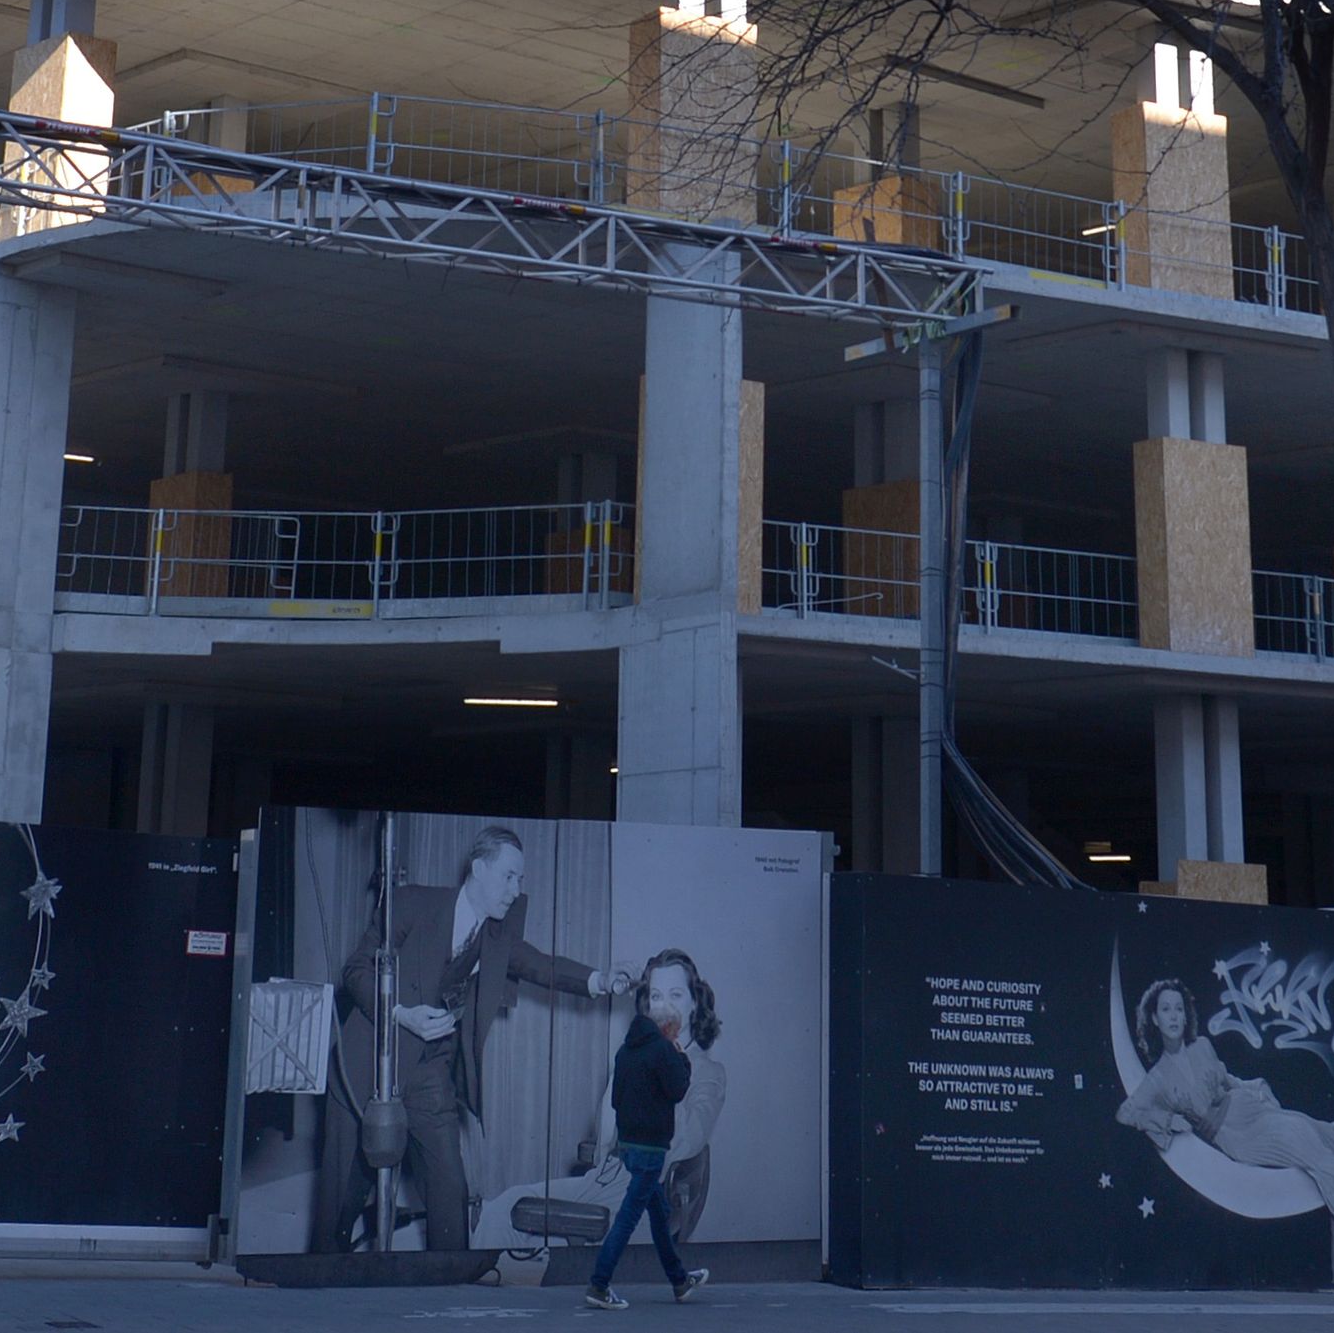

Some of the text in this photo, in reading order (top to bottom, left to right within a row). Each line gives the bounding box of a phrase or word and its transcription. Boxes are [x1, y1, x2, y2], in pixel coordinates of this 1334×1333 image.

[961, 979, 985, 992] AND
[986, 981, 1042, 996] CURIOSITY
[932, 994, 1034, 1012] ABOUT THE FUTURE
[940, 1012, 1026, 1028] SEEMED BETTER
[930, 1028, 1035, 1046] THAN GUARANTEES.
[907, 1061, 1055, 1081] THE UNKNOWN WAS ALWAYS
[918, 1079, 935, 1092] SO
[935, 1080, 1001, 1095] ATTRACTIVE
[1001, 1083, 1017, 1095] TO
[1017, 1085, 1034, 1097] ME
[944, 1098, 968, 1111] AND
[969, 1099, 999, 1112] STILL
